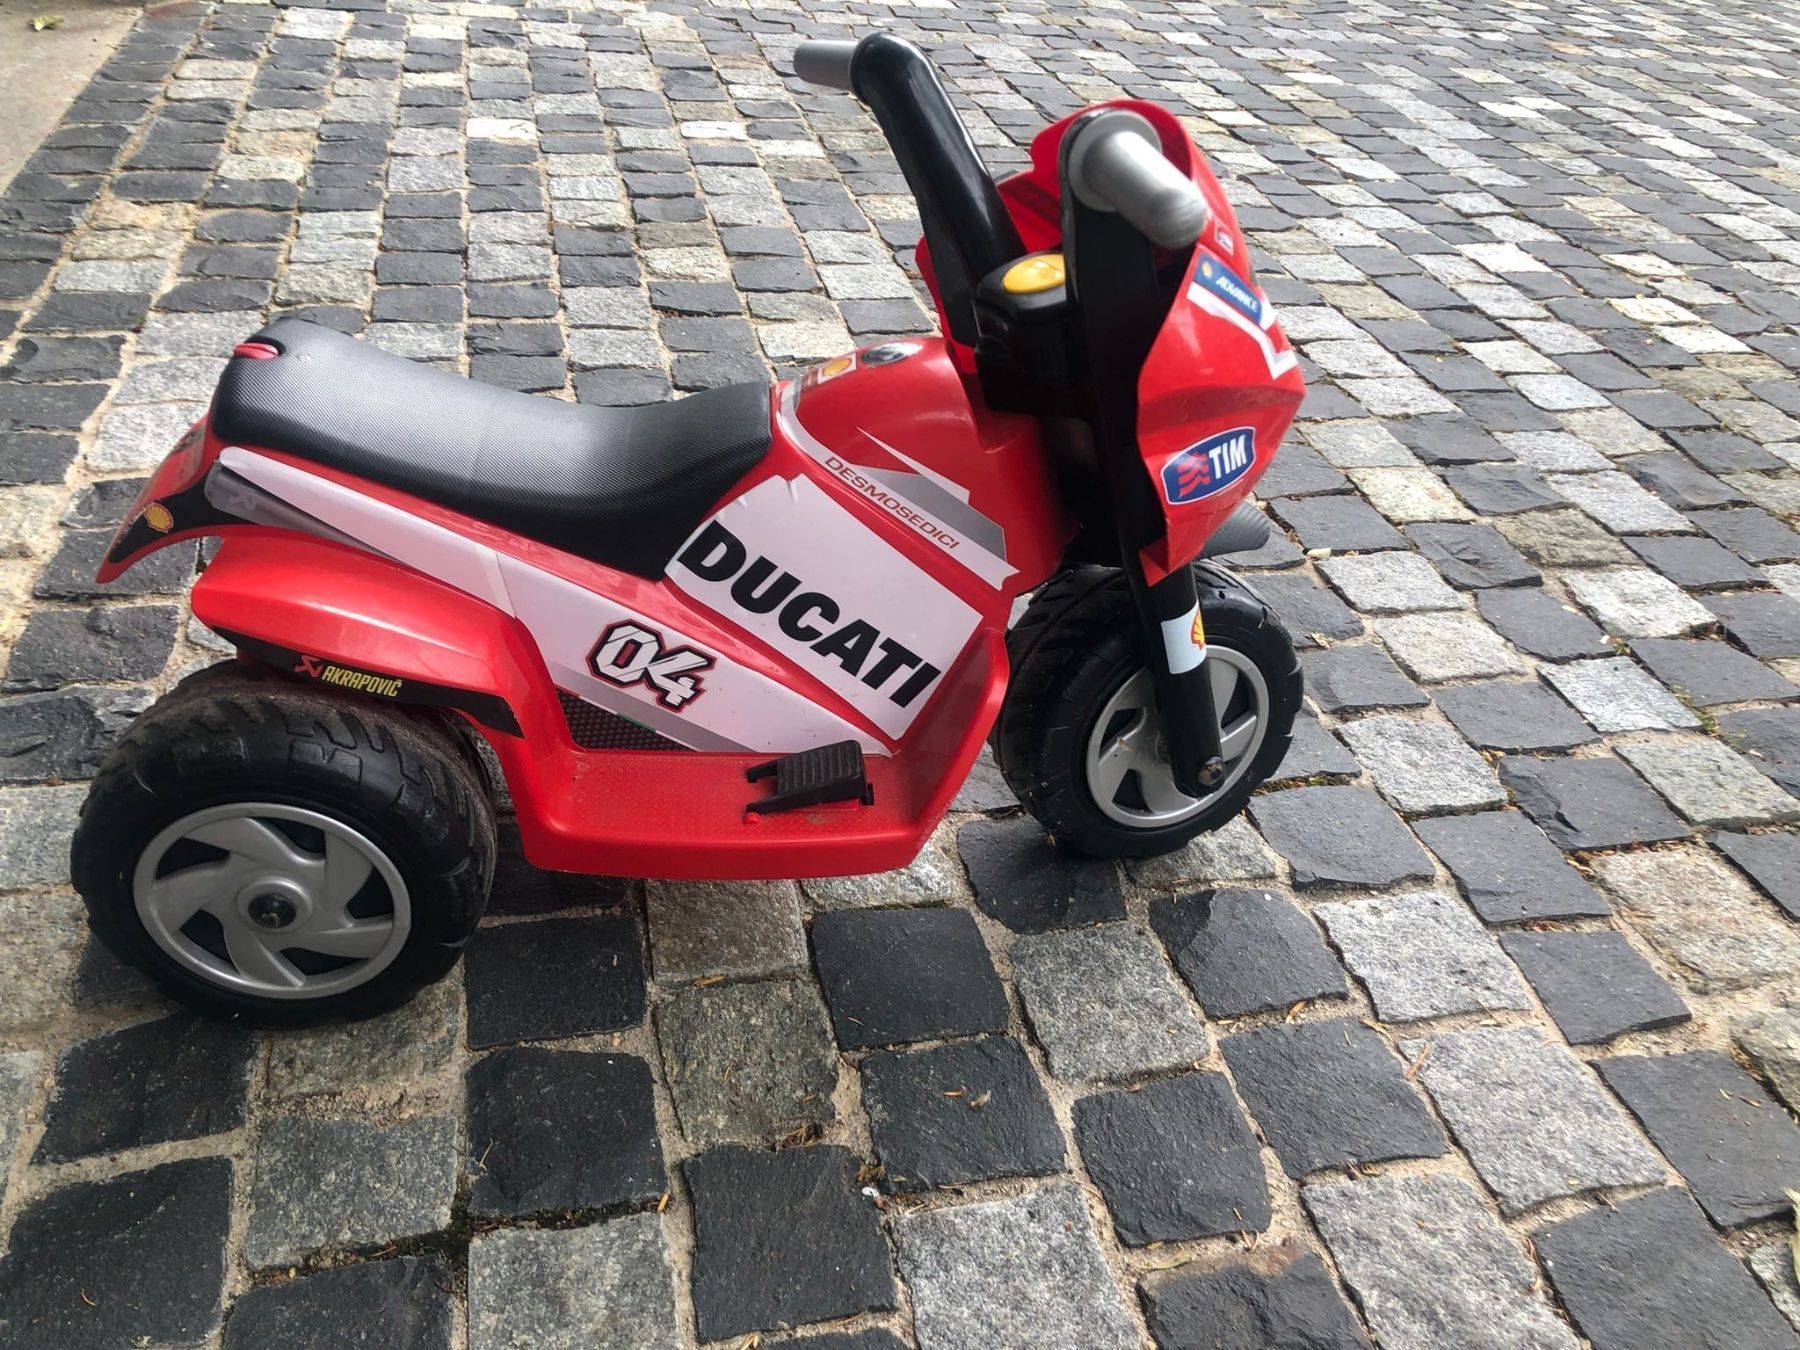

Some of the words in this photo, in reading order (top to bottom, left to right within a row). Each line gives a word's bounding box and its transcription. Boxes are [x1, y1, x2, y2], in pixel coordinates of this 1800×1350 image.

[1215, 276, 1258, 313] ADVANCE
[1208, 434, 1248, 479] TIM
[824, 456, 960, 550] DESMOSEDICI
[676, 519, 942, 708] DUCATI
[587, 620, 714, 711] 04
